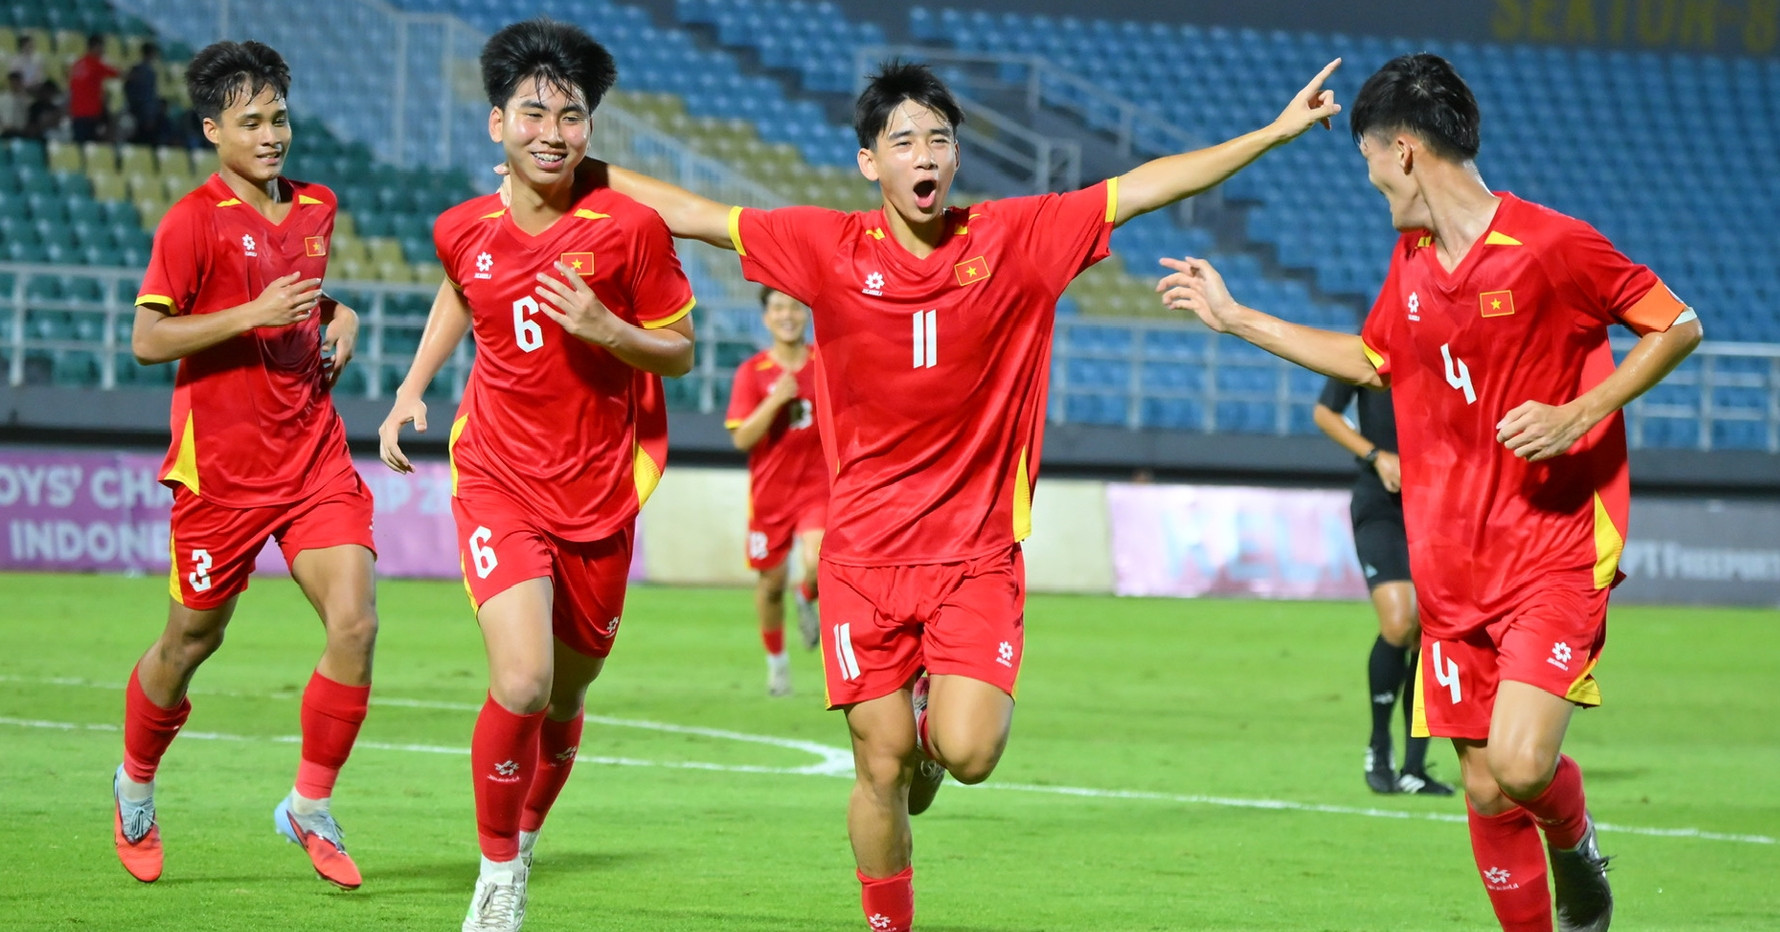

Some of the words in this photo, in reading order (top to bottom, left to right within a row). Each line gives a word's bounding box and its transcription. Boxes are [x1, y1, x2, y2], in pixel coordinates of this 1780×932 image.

[513, 295, 544, 353] 6
[912, 309, 937, 369] 11
[1440, 343, 1477, 405] 4
[189, 549, 213, 592] 3
[469, 526, 498, 579] 6
[834, 622, 861, 681] 11
[1432, 641, 1462, 705] 4
